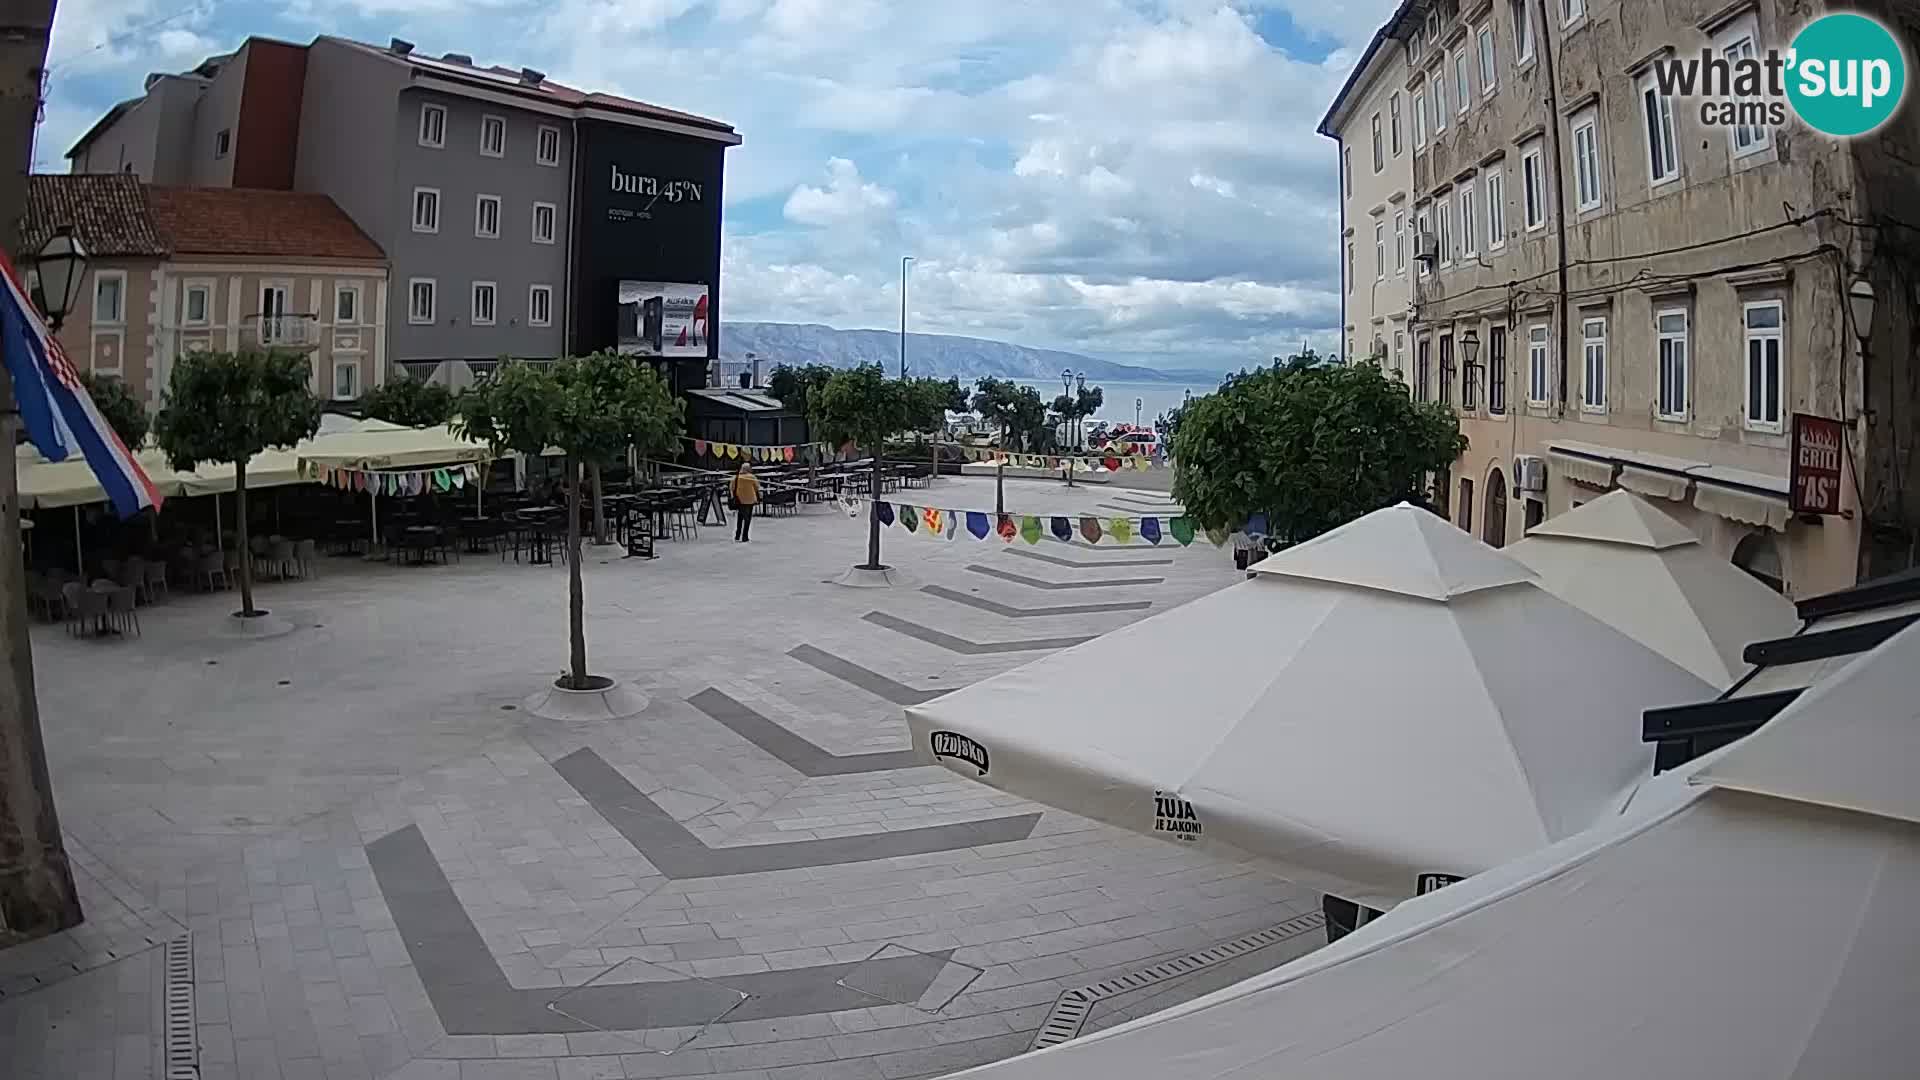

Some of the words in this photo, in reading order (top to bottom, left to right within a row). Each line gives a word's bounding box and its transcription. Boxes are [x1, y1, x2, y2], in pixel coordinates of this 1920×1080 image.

[611, 165, 657, 196] bura
[1800, 447, 1839, 471] GRILL
[1154, 790, 1197, 821] ŽUJA
[1155, 818, 1164, 831] JE
[1166, 819, 1202, 834] ZAKON!
